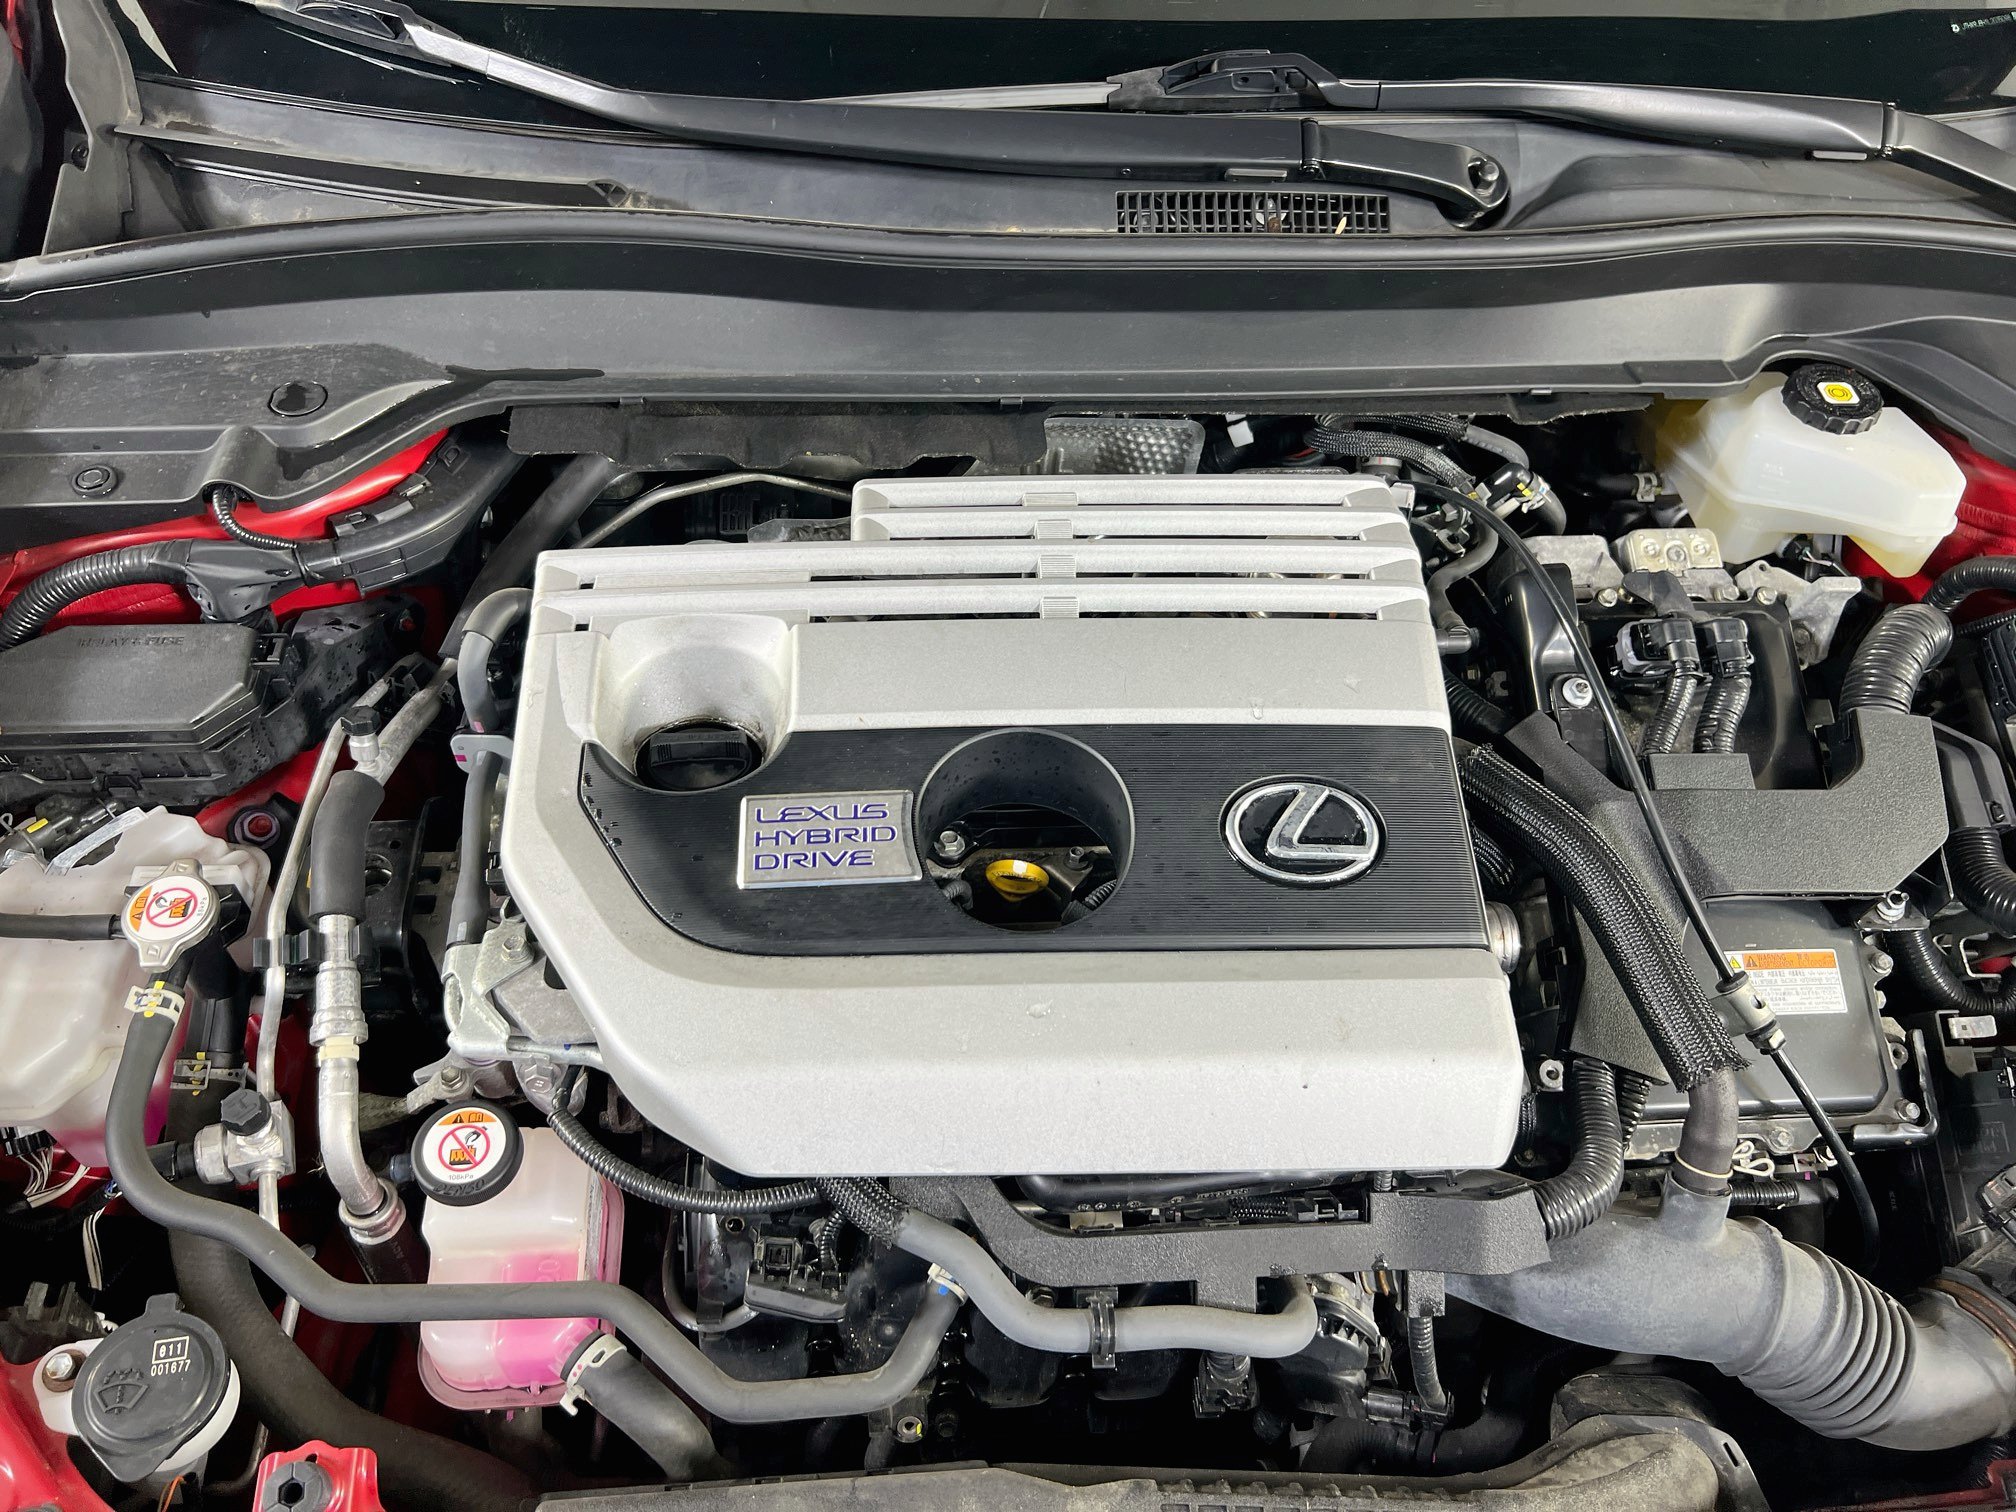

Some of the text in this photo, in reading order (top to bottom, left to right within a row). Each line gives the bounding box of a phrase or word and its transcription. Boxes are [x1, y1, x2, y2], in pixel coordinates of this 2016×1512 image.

[145, 635, 185, 647] FUSE
[754, 802, 889, 824] LEXUS
[753, 825, 898, 847] HYBRID
[752, 848, 876, 871] DRIVE
[432, 1178, 486, 1197] DENSO
[158, 1342, 183, 1359] 011
[150, 1359, 192, 1377] 001677
